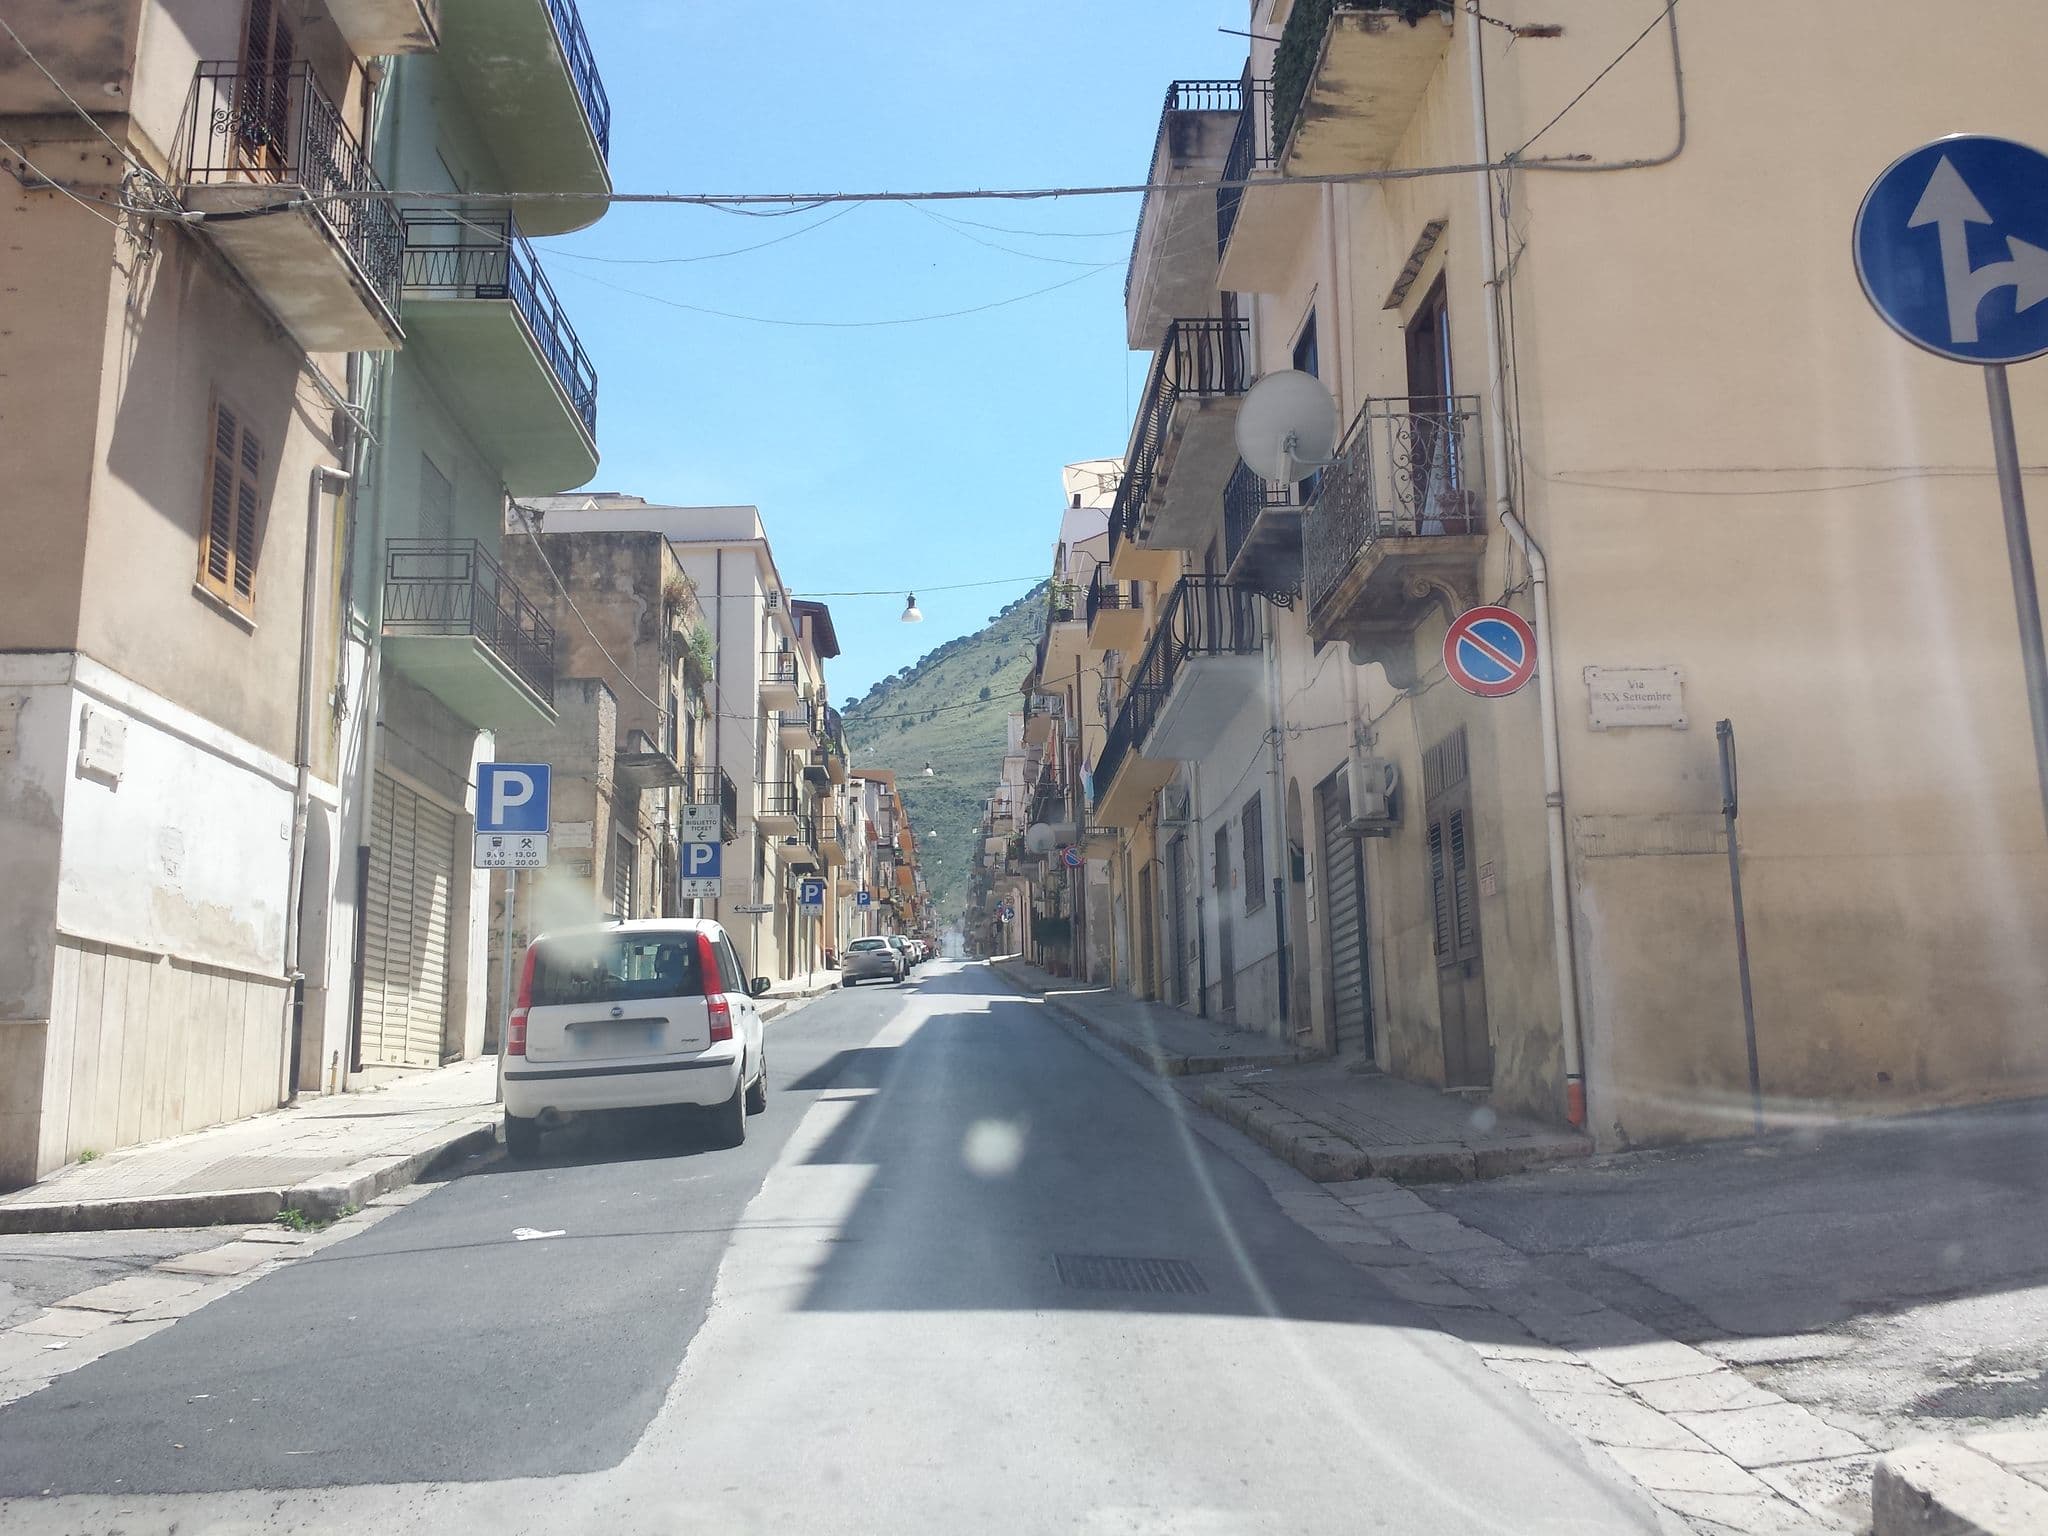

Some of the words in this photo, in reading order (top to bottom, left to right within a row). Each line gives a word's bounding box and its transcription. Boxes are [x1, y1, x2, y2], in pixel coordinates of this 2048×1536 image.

[1626, 680, 1644, 689] Via
[1602, 693, 1620, 702] XX
[1623, 691, 1672, 702] Settembre
[492, 770, 534, 825] P
[690, 843, 713, 874] P
[805, 884, 818, 902] P
[859, 893, 868, 903] P
